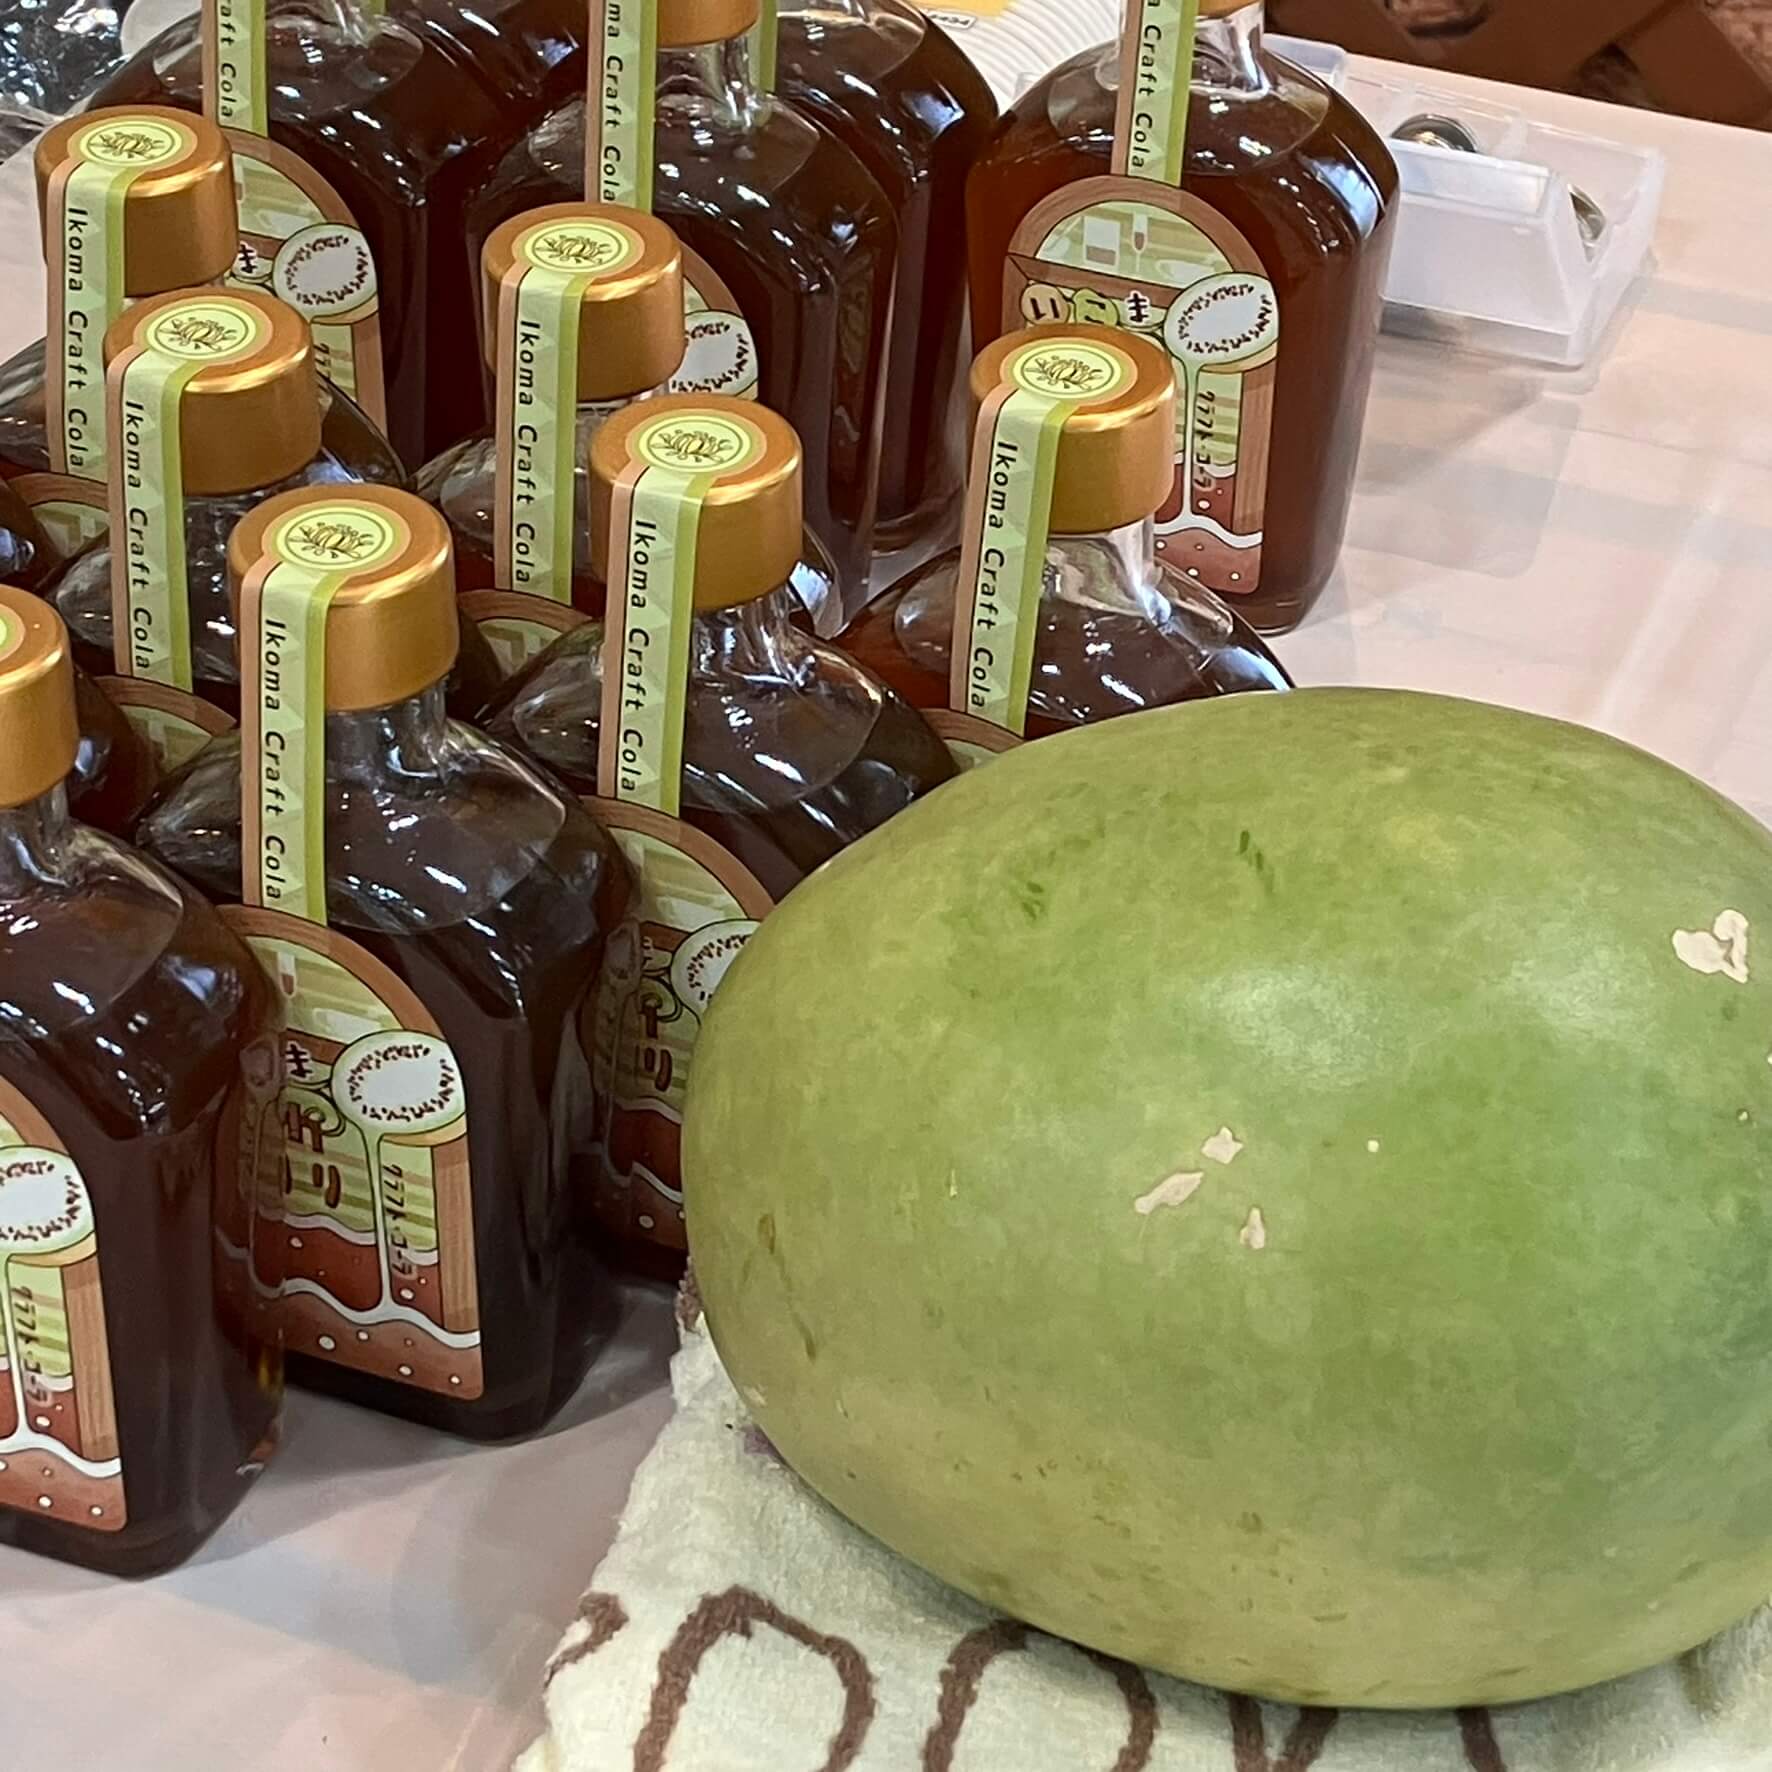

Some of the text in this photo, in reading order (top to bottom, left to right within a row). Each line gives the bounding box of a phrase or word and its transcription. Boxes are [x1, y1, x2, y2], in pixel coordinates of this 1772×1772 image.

[220, 0, 237, 117] aft Cola
[602, 145, 621, 202] Cola
[604, 55, 623, 128] Craft
[1131, 112, 1153, 168] Cola
[1138, 24, 1162, 97] Craft
[67, 207, 89, 467] Ikoma Craft Cola
[515, 319, 541, 583] Ikoma Craft Cola
[125, 400, 154, 669] Ikoma Craft Cola
[621, 519, 657, 792] Ikoma Craft Cola
[971, 440, 1019, 708] Ikoma Craft Cola
[265, 618, 287, 900] Ikoma Craft Cola
